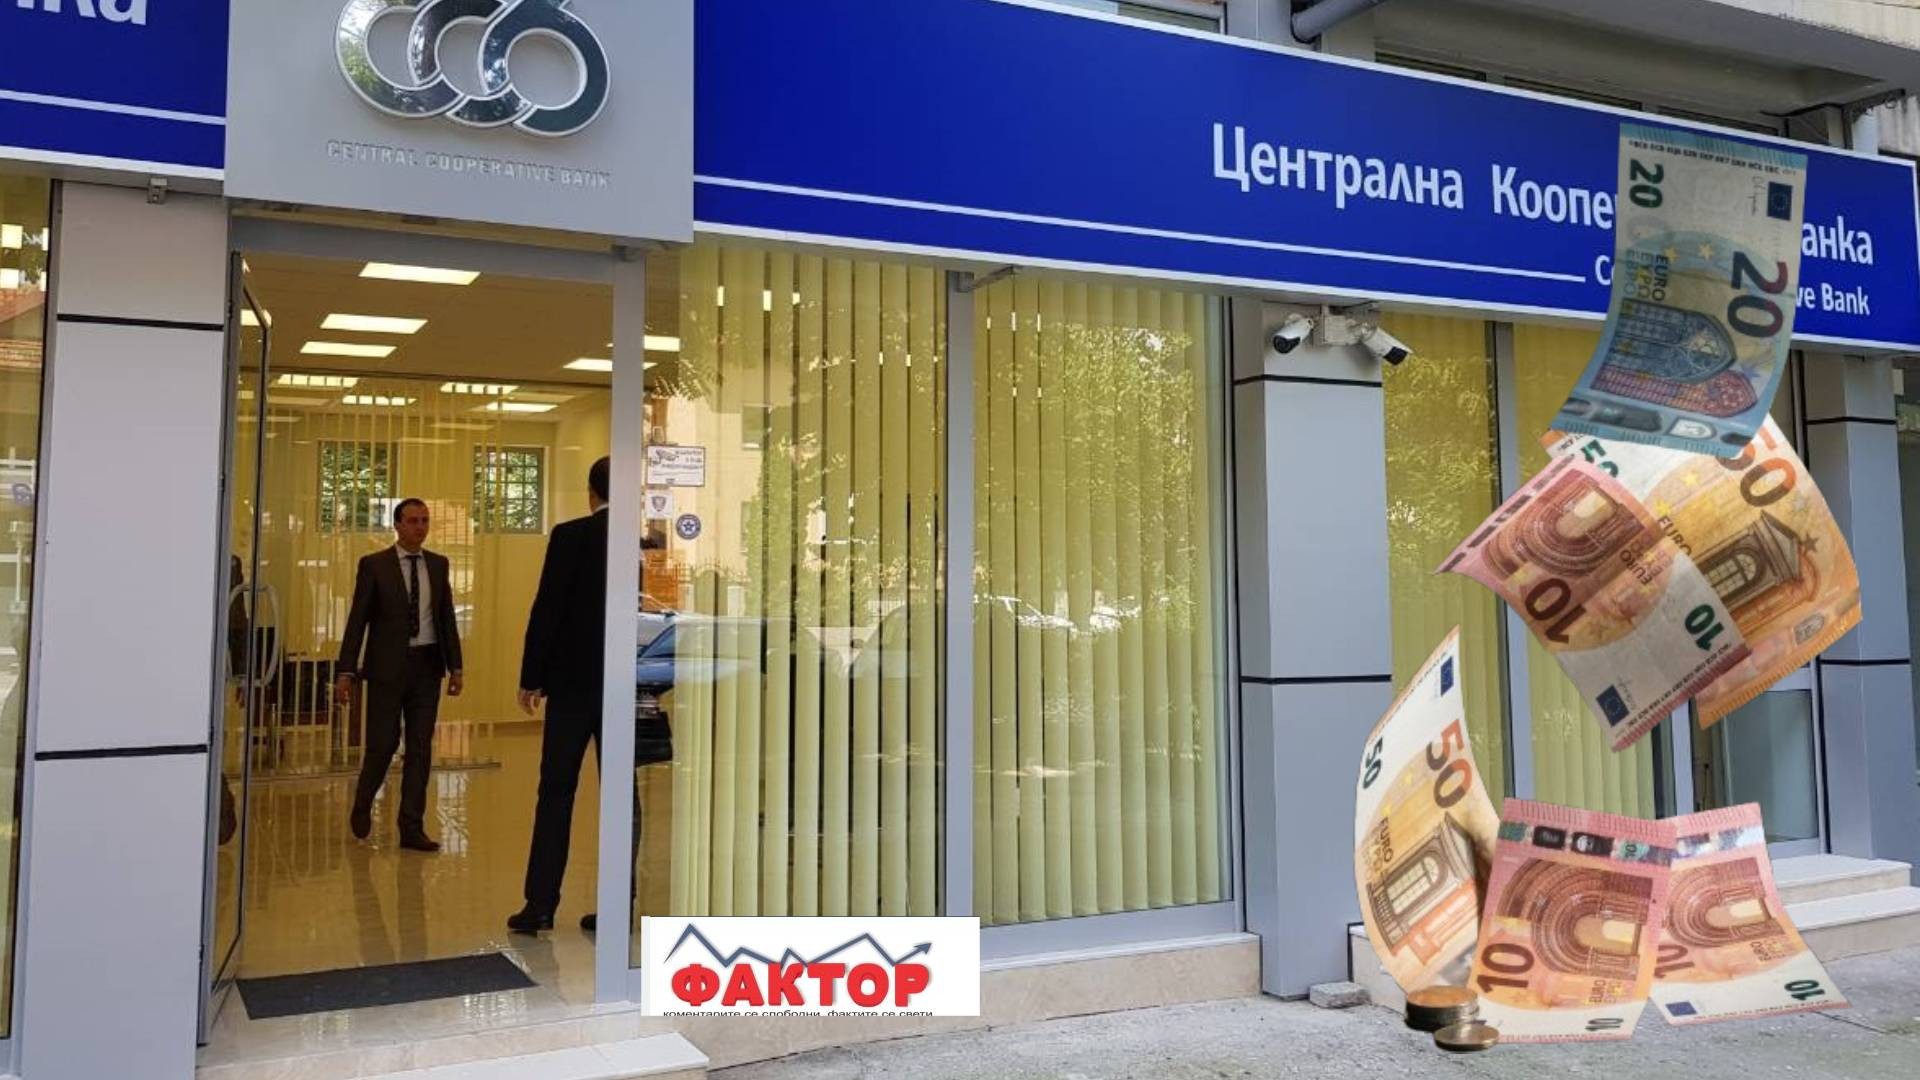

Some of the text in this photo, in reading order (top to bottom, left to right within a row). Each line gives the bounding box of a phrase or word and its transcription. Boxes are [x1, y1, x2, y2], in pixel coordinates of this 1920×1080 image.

[327, 140, 610, 189] CENTRAL COOPERATIVE BANK
[1213, 122, 1873, 265] Централна Коопе анка
[1821, 282, 1870, 315] Bank
